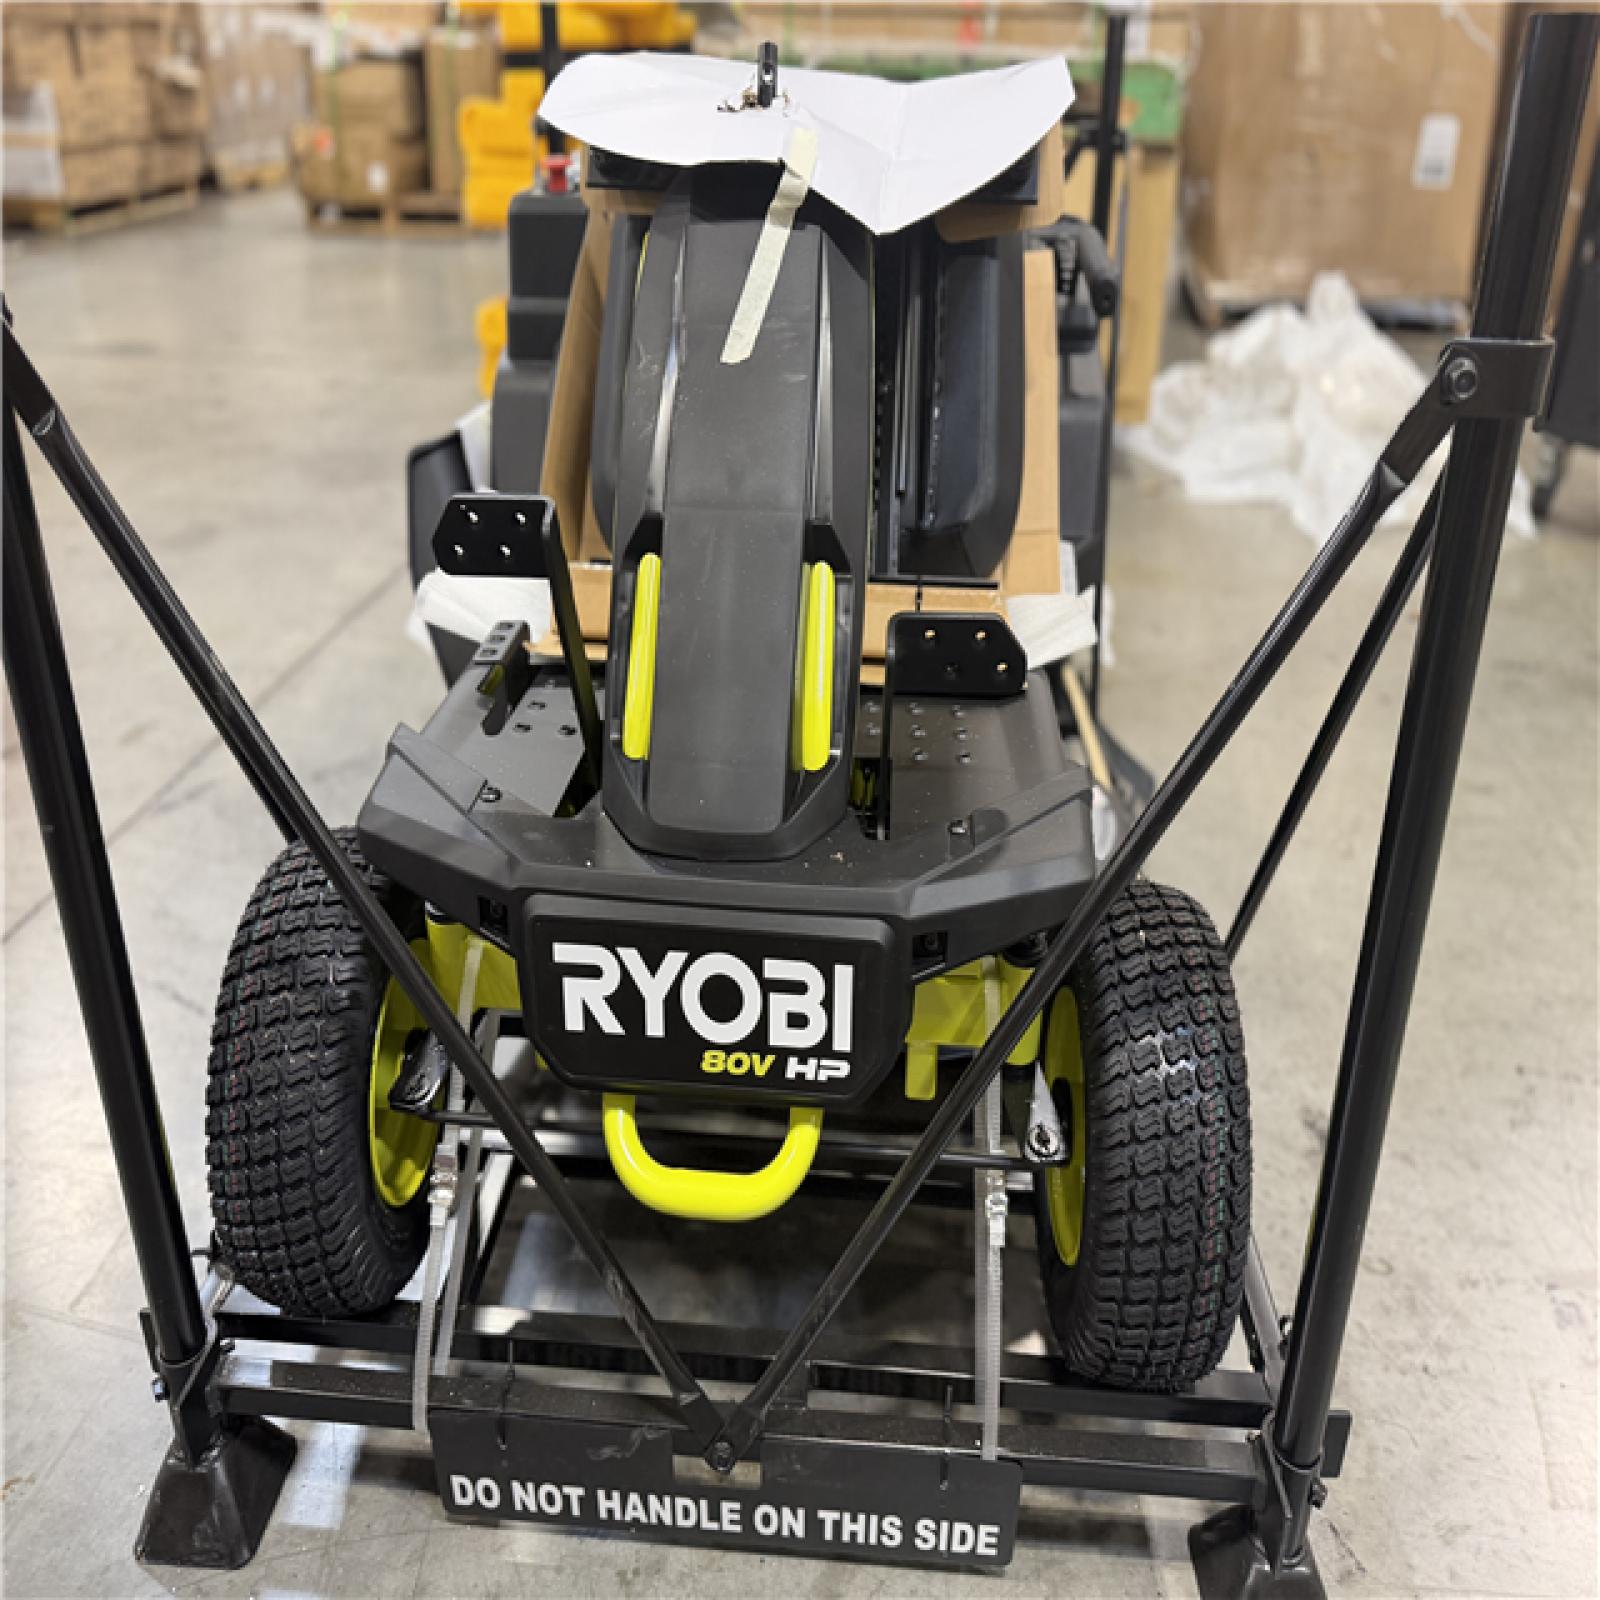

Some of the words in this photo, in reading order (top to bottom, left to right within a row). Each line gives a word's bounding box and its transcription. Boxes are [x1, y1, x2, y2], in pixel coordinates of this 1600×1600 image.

[552, 942, 855, 1053] RYOBI
[701, 1049, 776, 1077] 80V
[784, 1056, 851, 1081] HP
[450, 1474, 501, 1509] DO
[511, 1480, 586, 1516] NOT
[597, 1489, 743, 1533] HANDLE
[754, 1504, 806, 1539] ON
[817, 1509, 903, 1548] THIS
[914, 1519, 1001, 1556] SIDE
